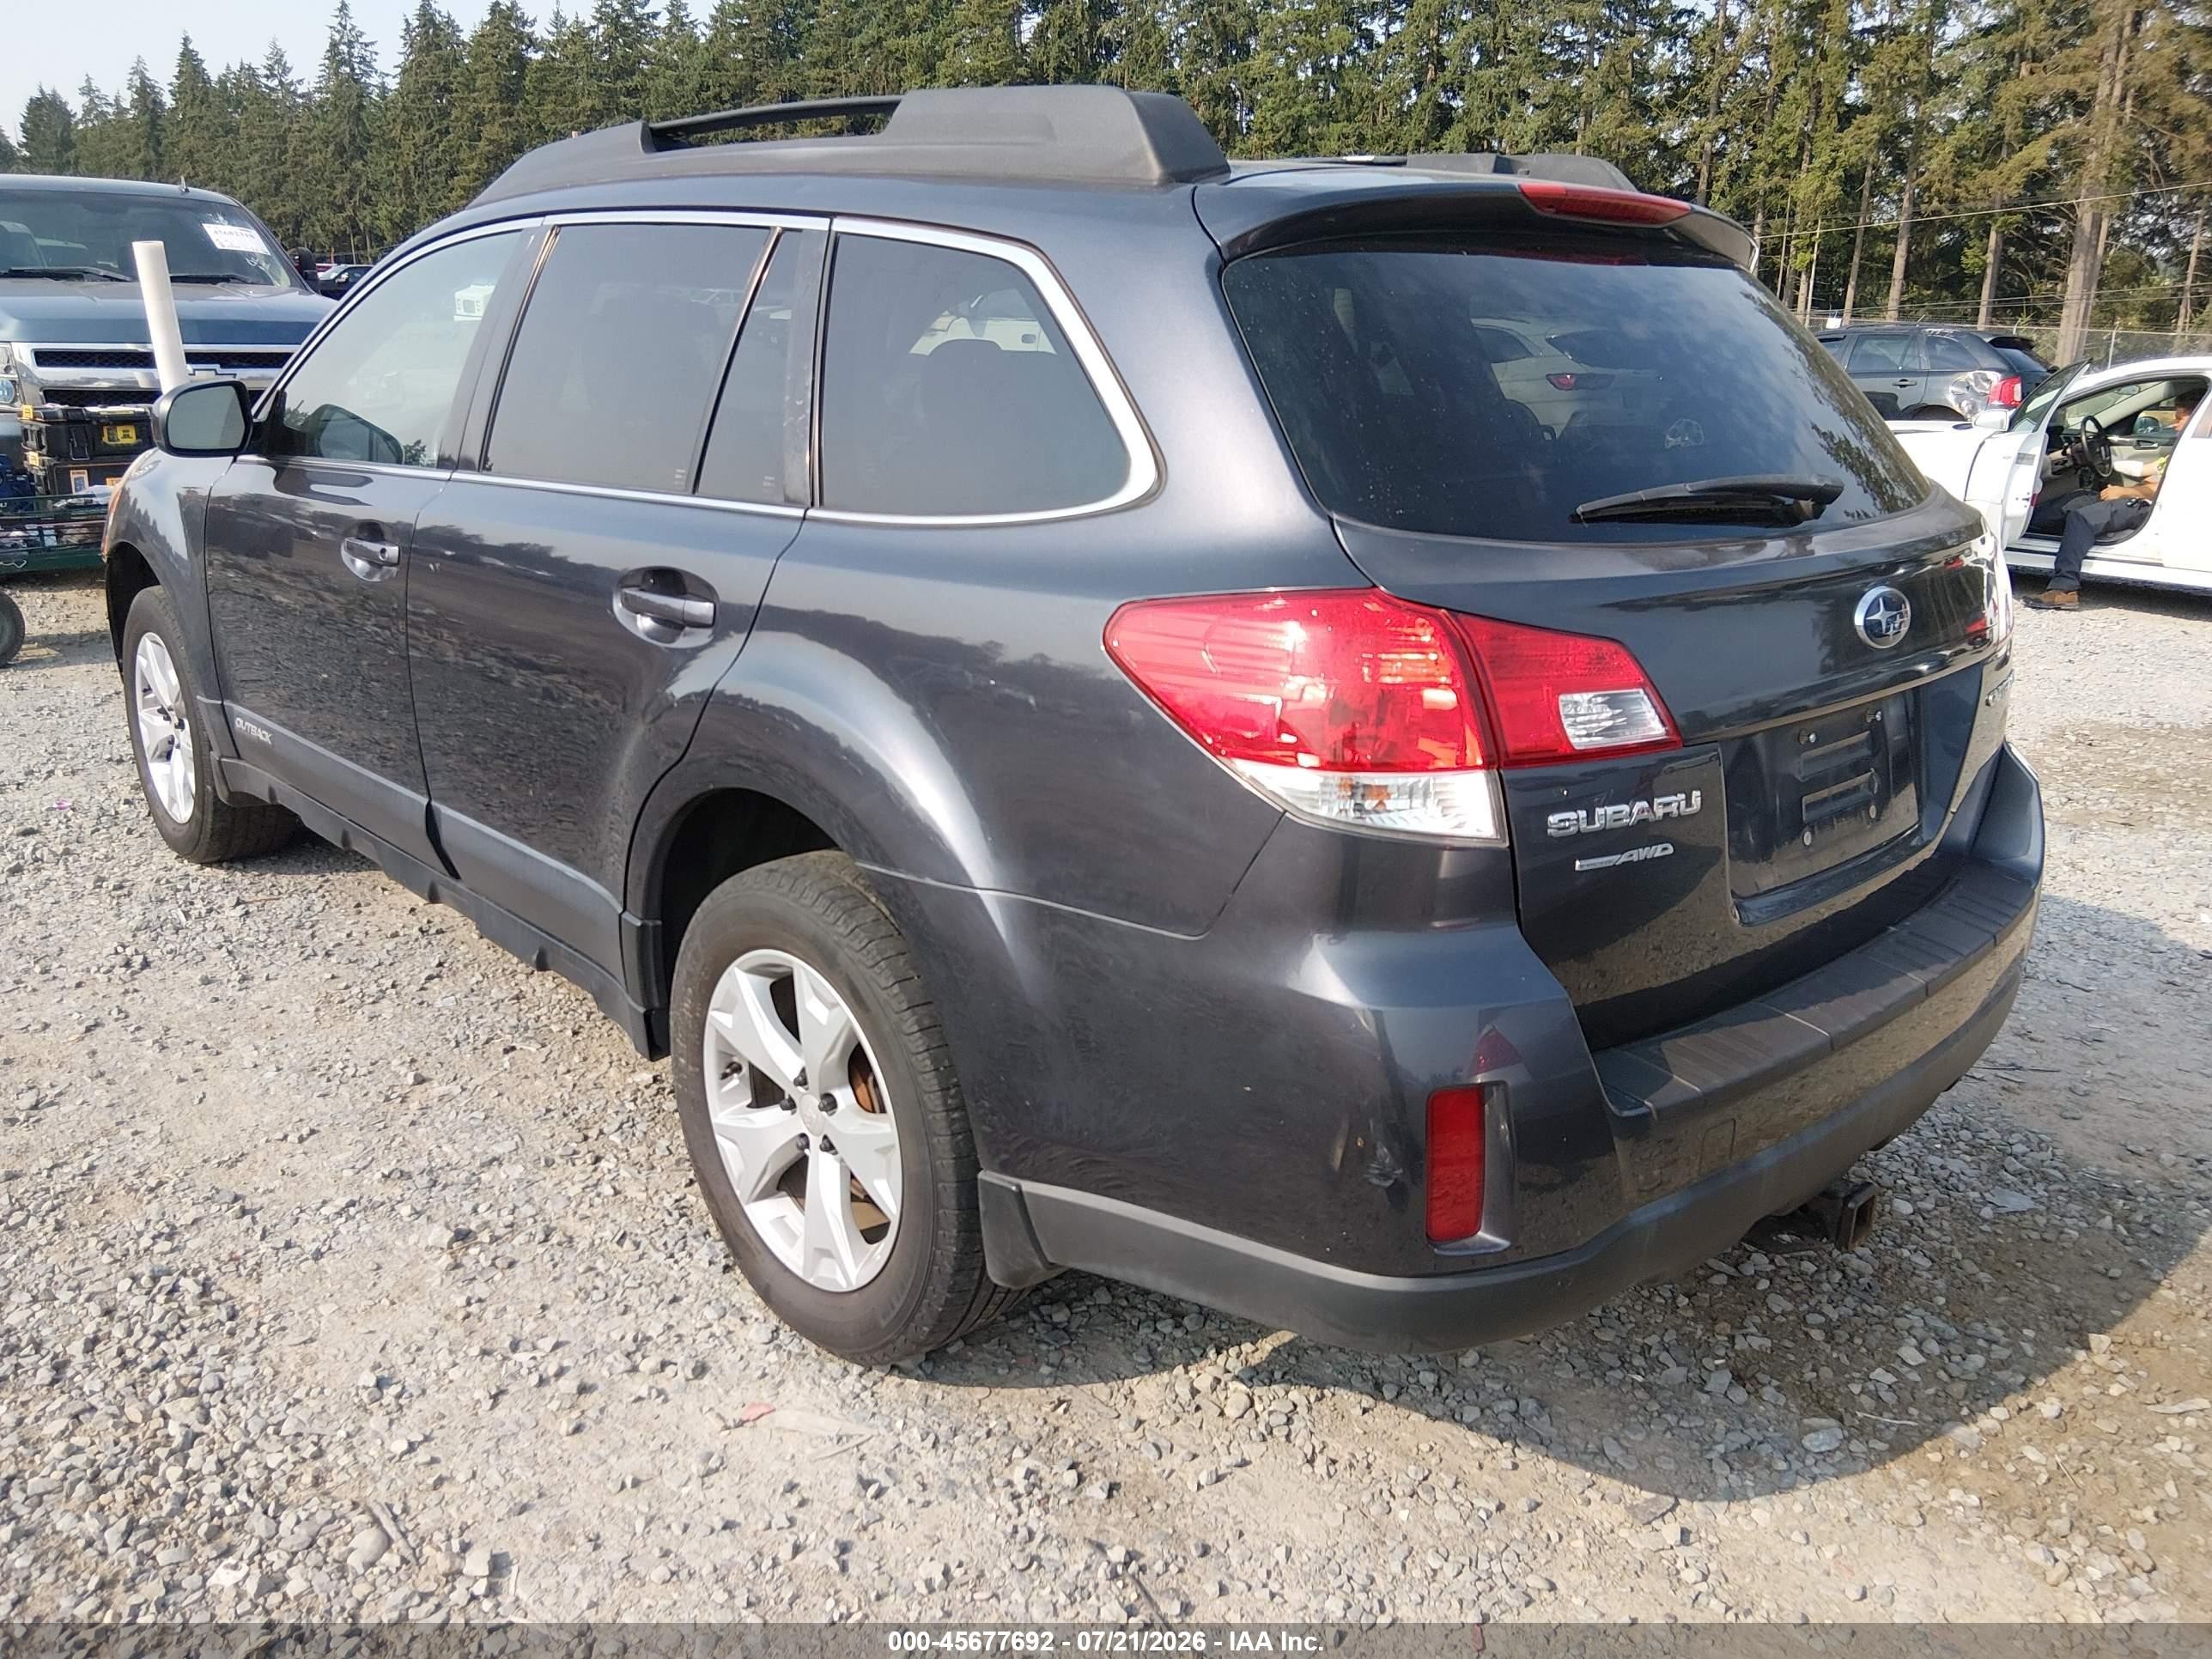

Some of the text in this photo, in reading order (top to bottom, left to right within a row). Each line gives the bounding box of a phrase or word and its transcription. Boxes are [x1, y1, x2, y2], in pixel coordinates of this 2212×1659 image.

[234, 717, 273, 744] OUTBACK
[1547, 790, 1702, 837] SUBARU
[1614, 842, 1674, 866] AWD
